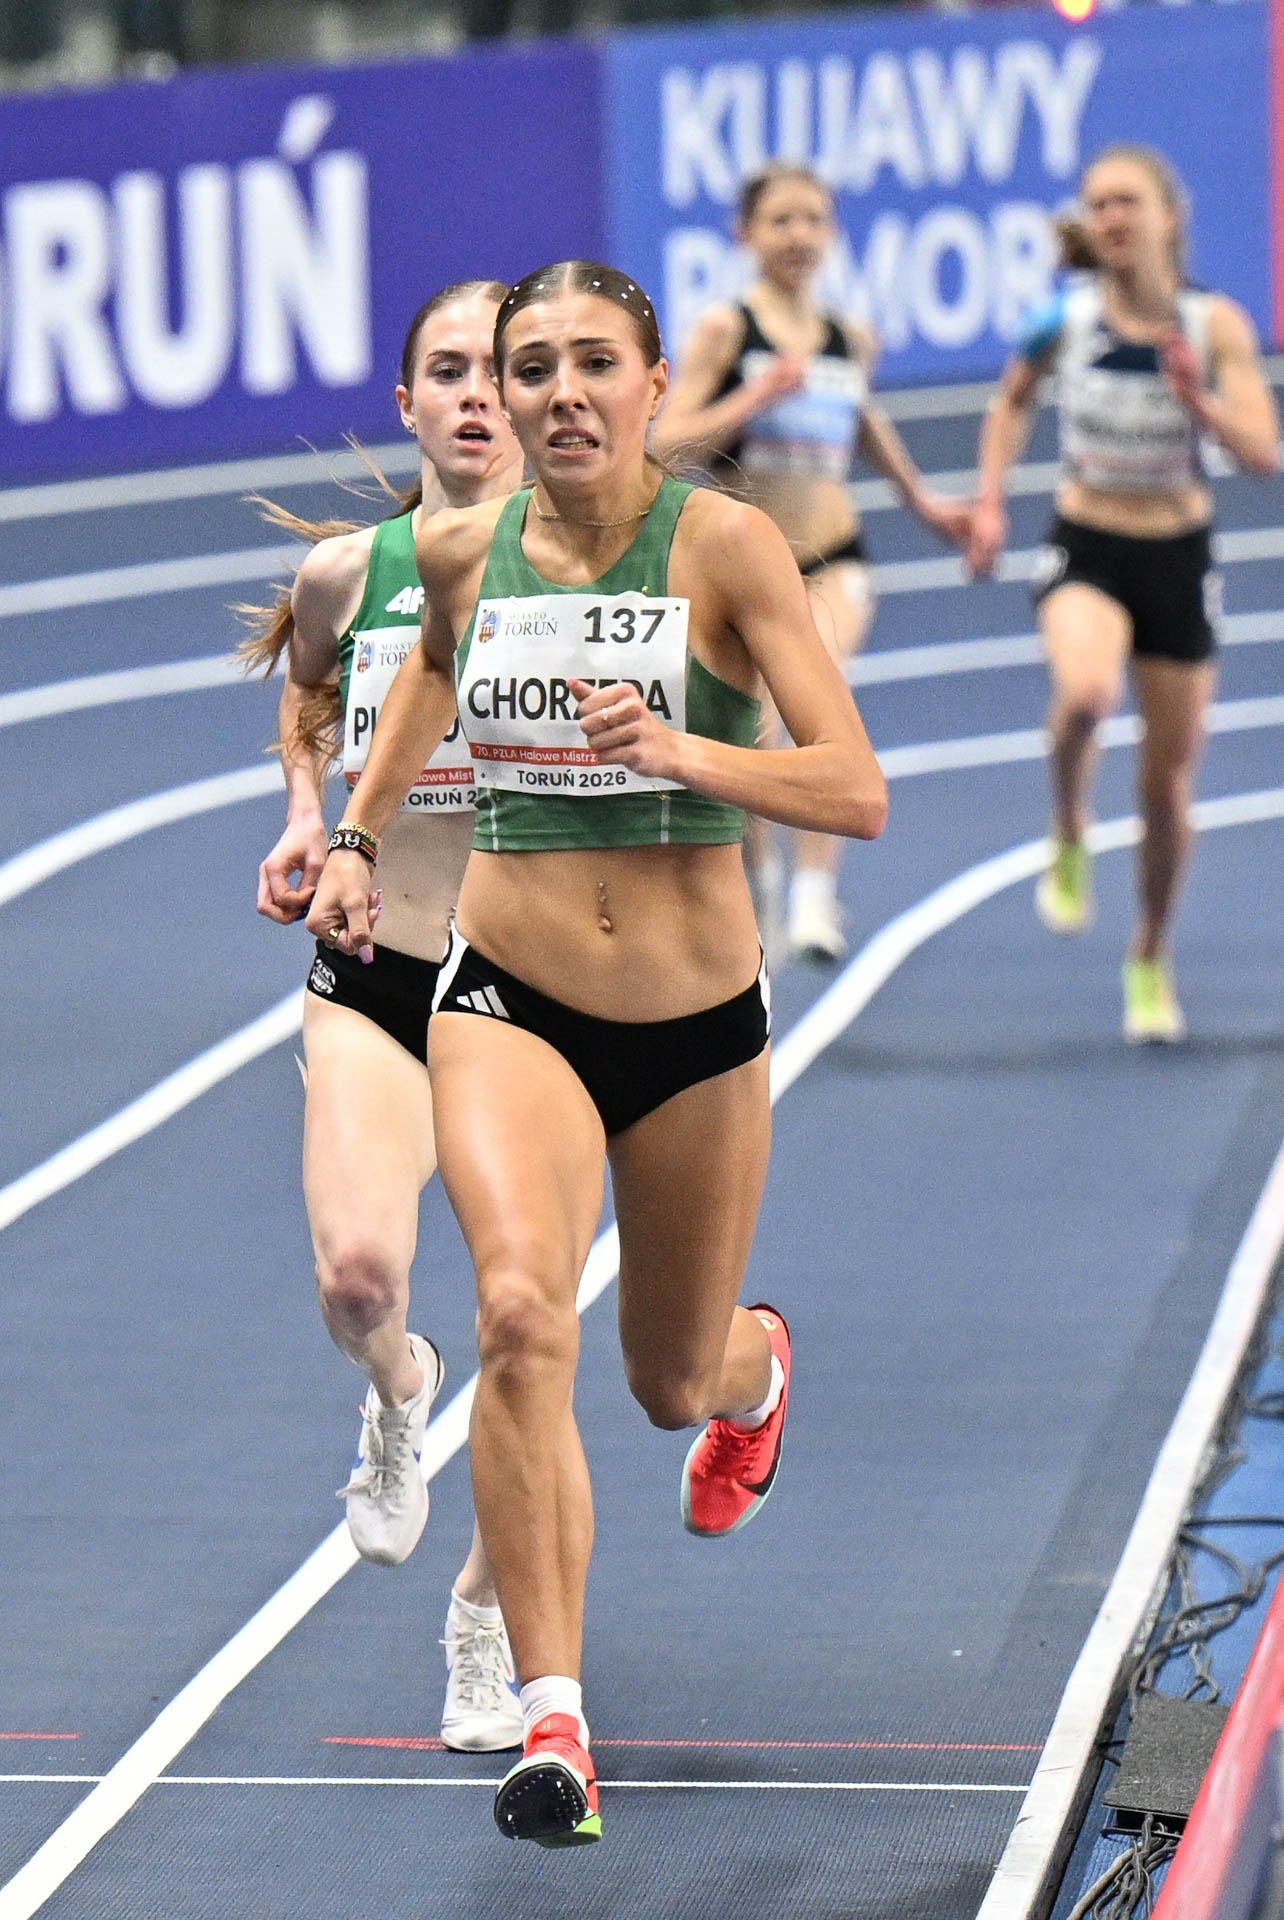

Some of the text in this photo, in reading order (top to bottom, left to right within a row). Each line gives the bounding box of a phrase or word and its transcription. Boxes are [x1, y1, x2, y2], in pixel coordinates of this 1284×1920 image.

[661, 36, 1102, 206] KUJAWY
[0, 95, 371, 422] RUŃ
[504, 617, 558, 636] TORUŃ
[584, 606, 666, 643] 137
[381, 642, 412, 651] MIAST
[378, 652, 408, 666] TOR
[468, 677, 672, 720] CHORA
[493, 749, 517, 759] PZLA
[520, 752, 560, 762] Halowe
[563, 752, 598, 763] Mistrz
[517, 769, 627, 787] TORUŃ 2026
[402, 787, 462, 806] ORUŃ
